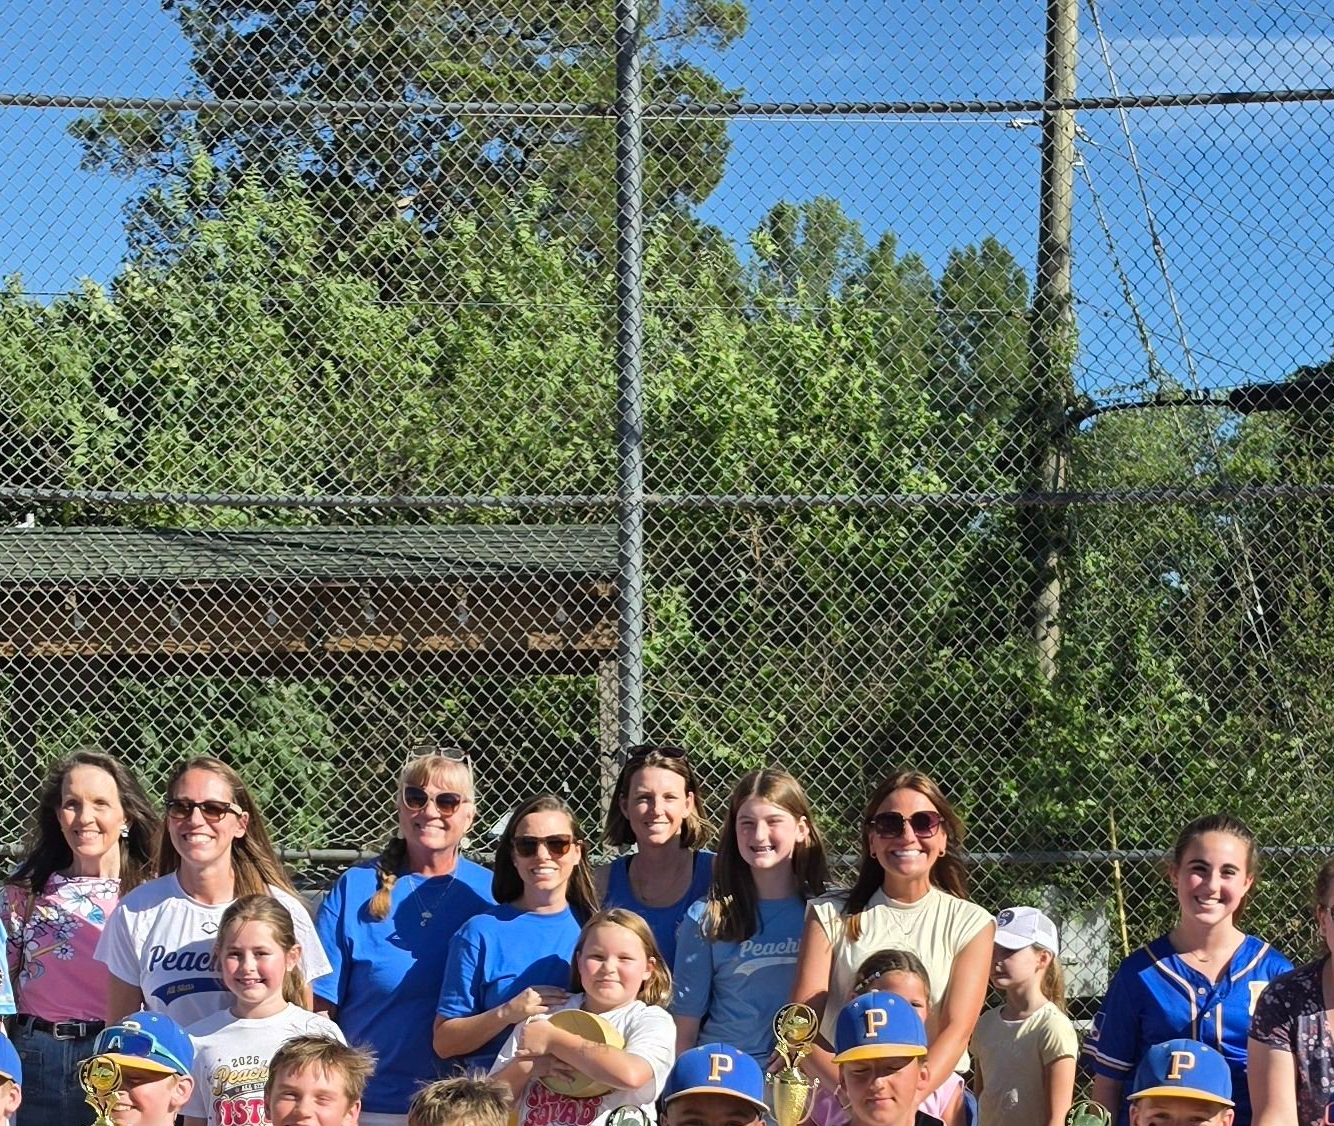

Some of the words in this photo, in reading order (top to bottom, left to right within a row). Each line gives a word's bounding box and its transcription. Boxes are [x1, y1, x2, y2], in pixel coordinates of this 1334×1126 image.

[865, 1008, 888, 1038] P
[231, 1055, 260, 1068] 2026
[708, 1053, 734, 1081] P
[1167, 1050, 1196, 1080] P
[213, 1098, 271, 1126] SIST
